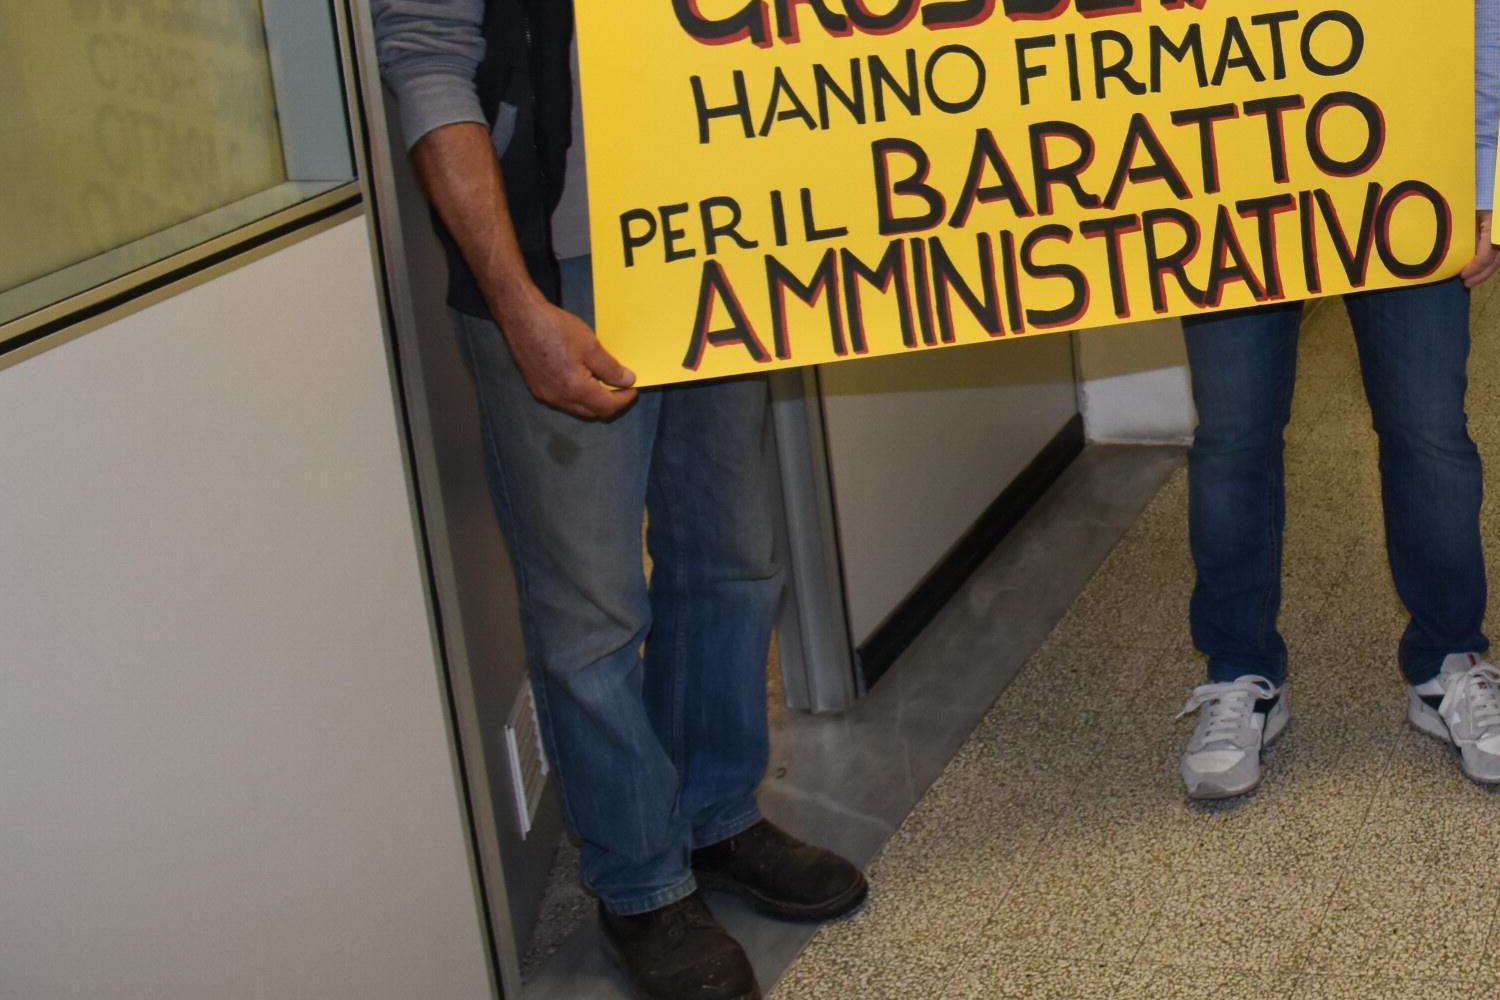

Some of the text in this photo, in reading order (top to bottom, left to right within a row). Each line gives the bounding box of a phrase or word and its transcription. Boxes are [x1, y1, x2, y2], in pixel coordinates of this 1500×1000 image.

[690, 9, 1365, 145] HANNO FIRMATO
[619, 90, 1387, 268] PER IL BARATTO
[682, 179, 1453, 371] AMMINISTRATIVO
